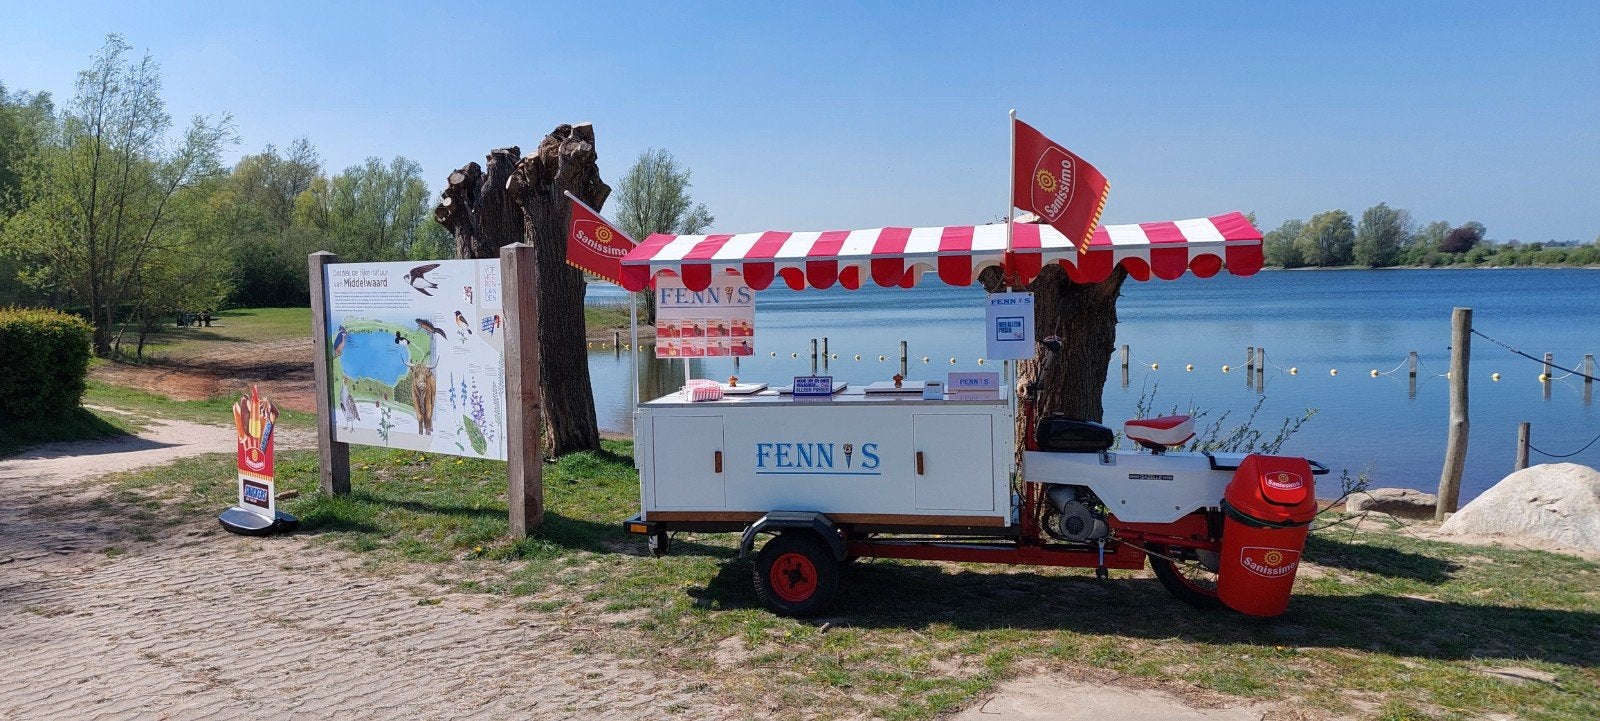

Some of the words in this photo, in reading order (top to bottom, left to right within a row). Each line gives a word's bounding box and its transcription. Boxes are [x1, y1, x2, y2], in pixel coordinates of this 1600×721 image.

[1045, 160, 1071, 217] Sanissimo
[576, 230, 628, 256] Sanissimo
[344, 278, 388, 288] Middelwaard
[1267, 479, 1301, 488] Sanissimo
[245, 485, 267, 501] SNICKERS
[1243, 557, 1296, 575] Sanissimo
